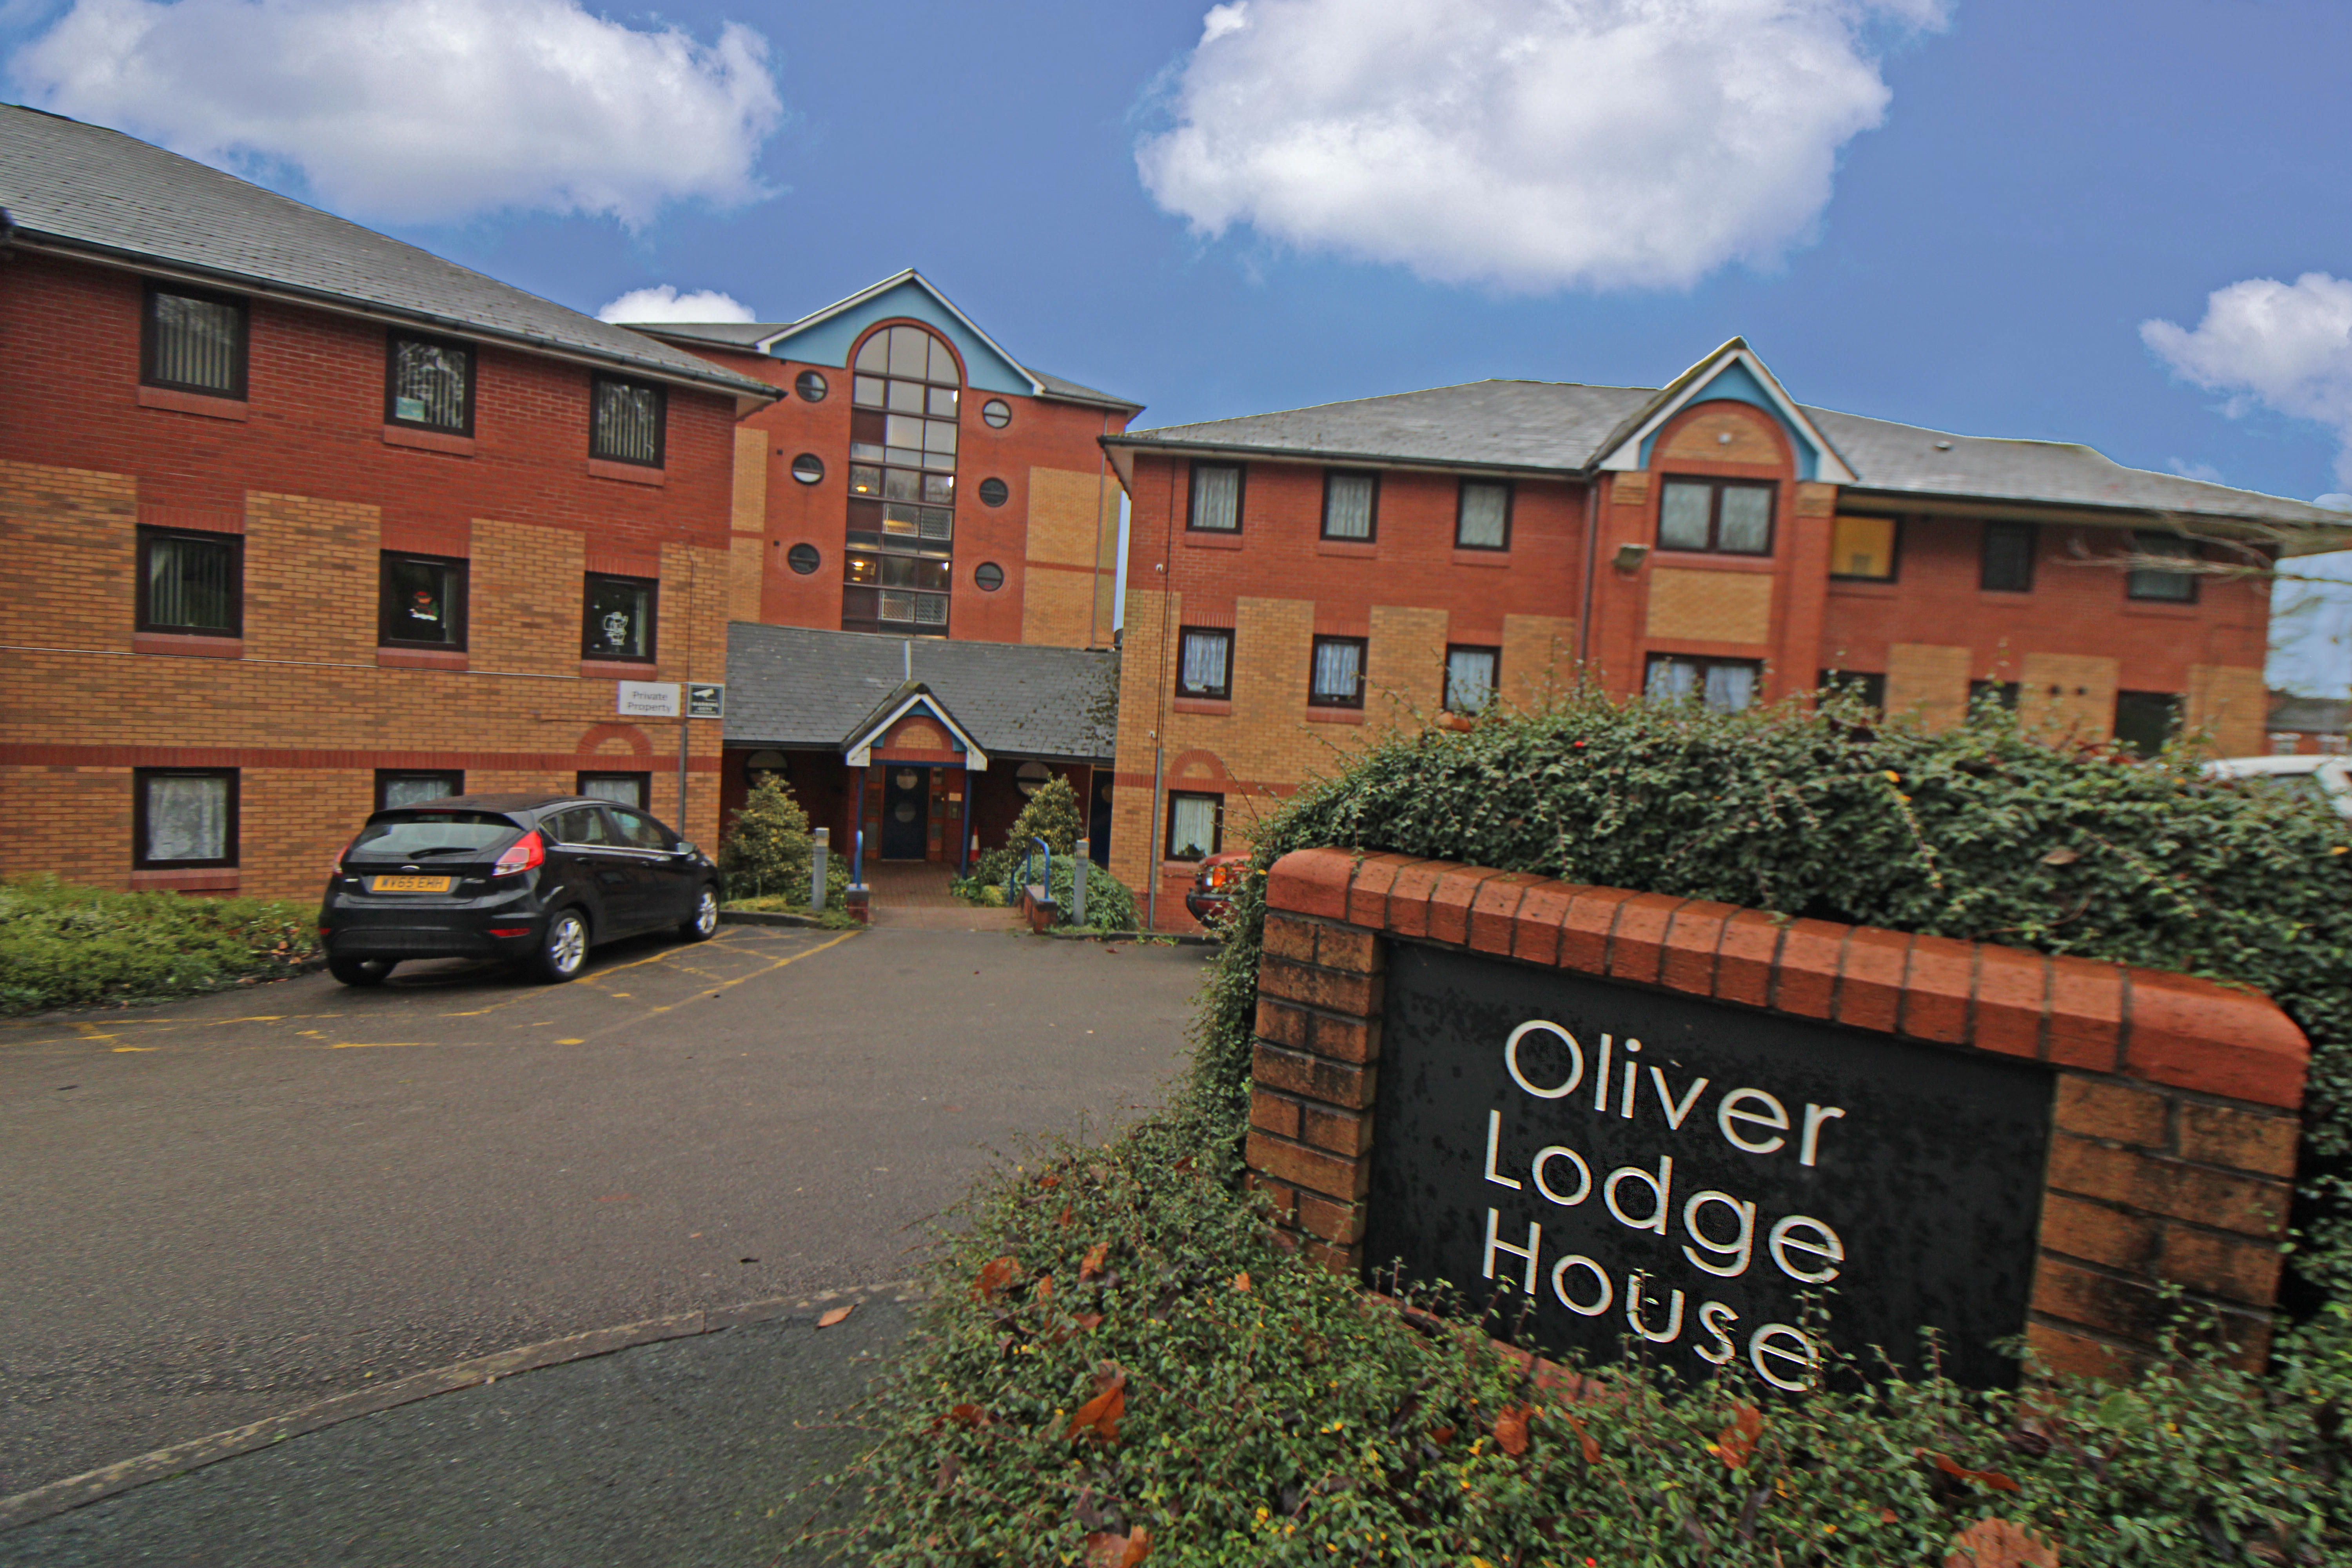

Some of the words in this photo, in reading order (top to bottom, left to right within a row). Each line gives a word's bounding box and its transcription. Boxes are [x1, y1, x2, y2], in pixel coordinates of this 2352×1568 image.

[627, 702, 672, 713] Property
[632, 691, 668, 701] Private
[1504, 1019, 1846, 1167] Oliver
[1485, 1109, 1844, 1283] Lodge
[1482, 1207, 1820, 1392] House
